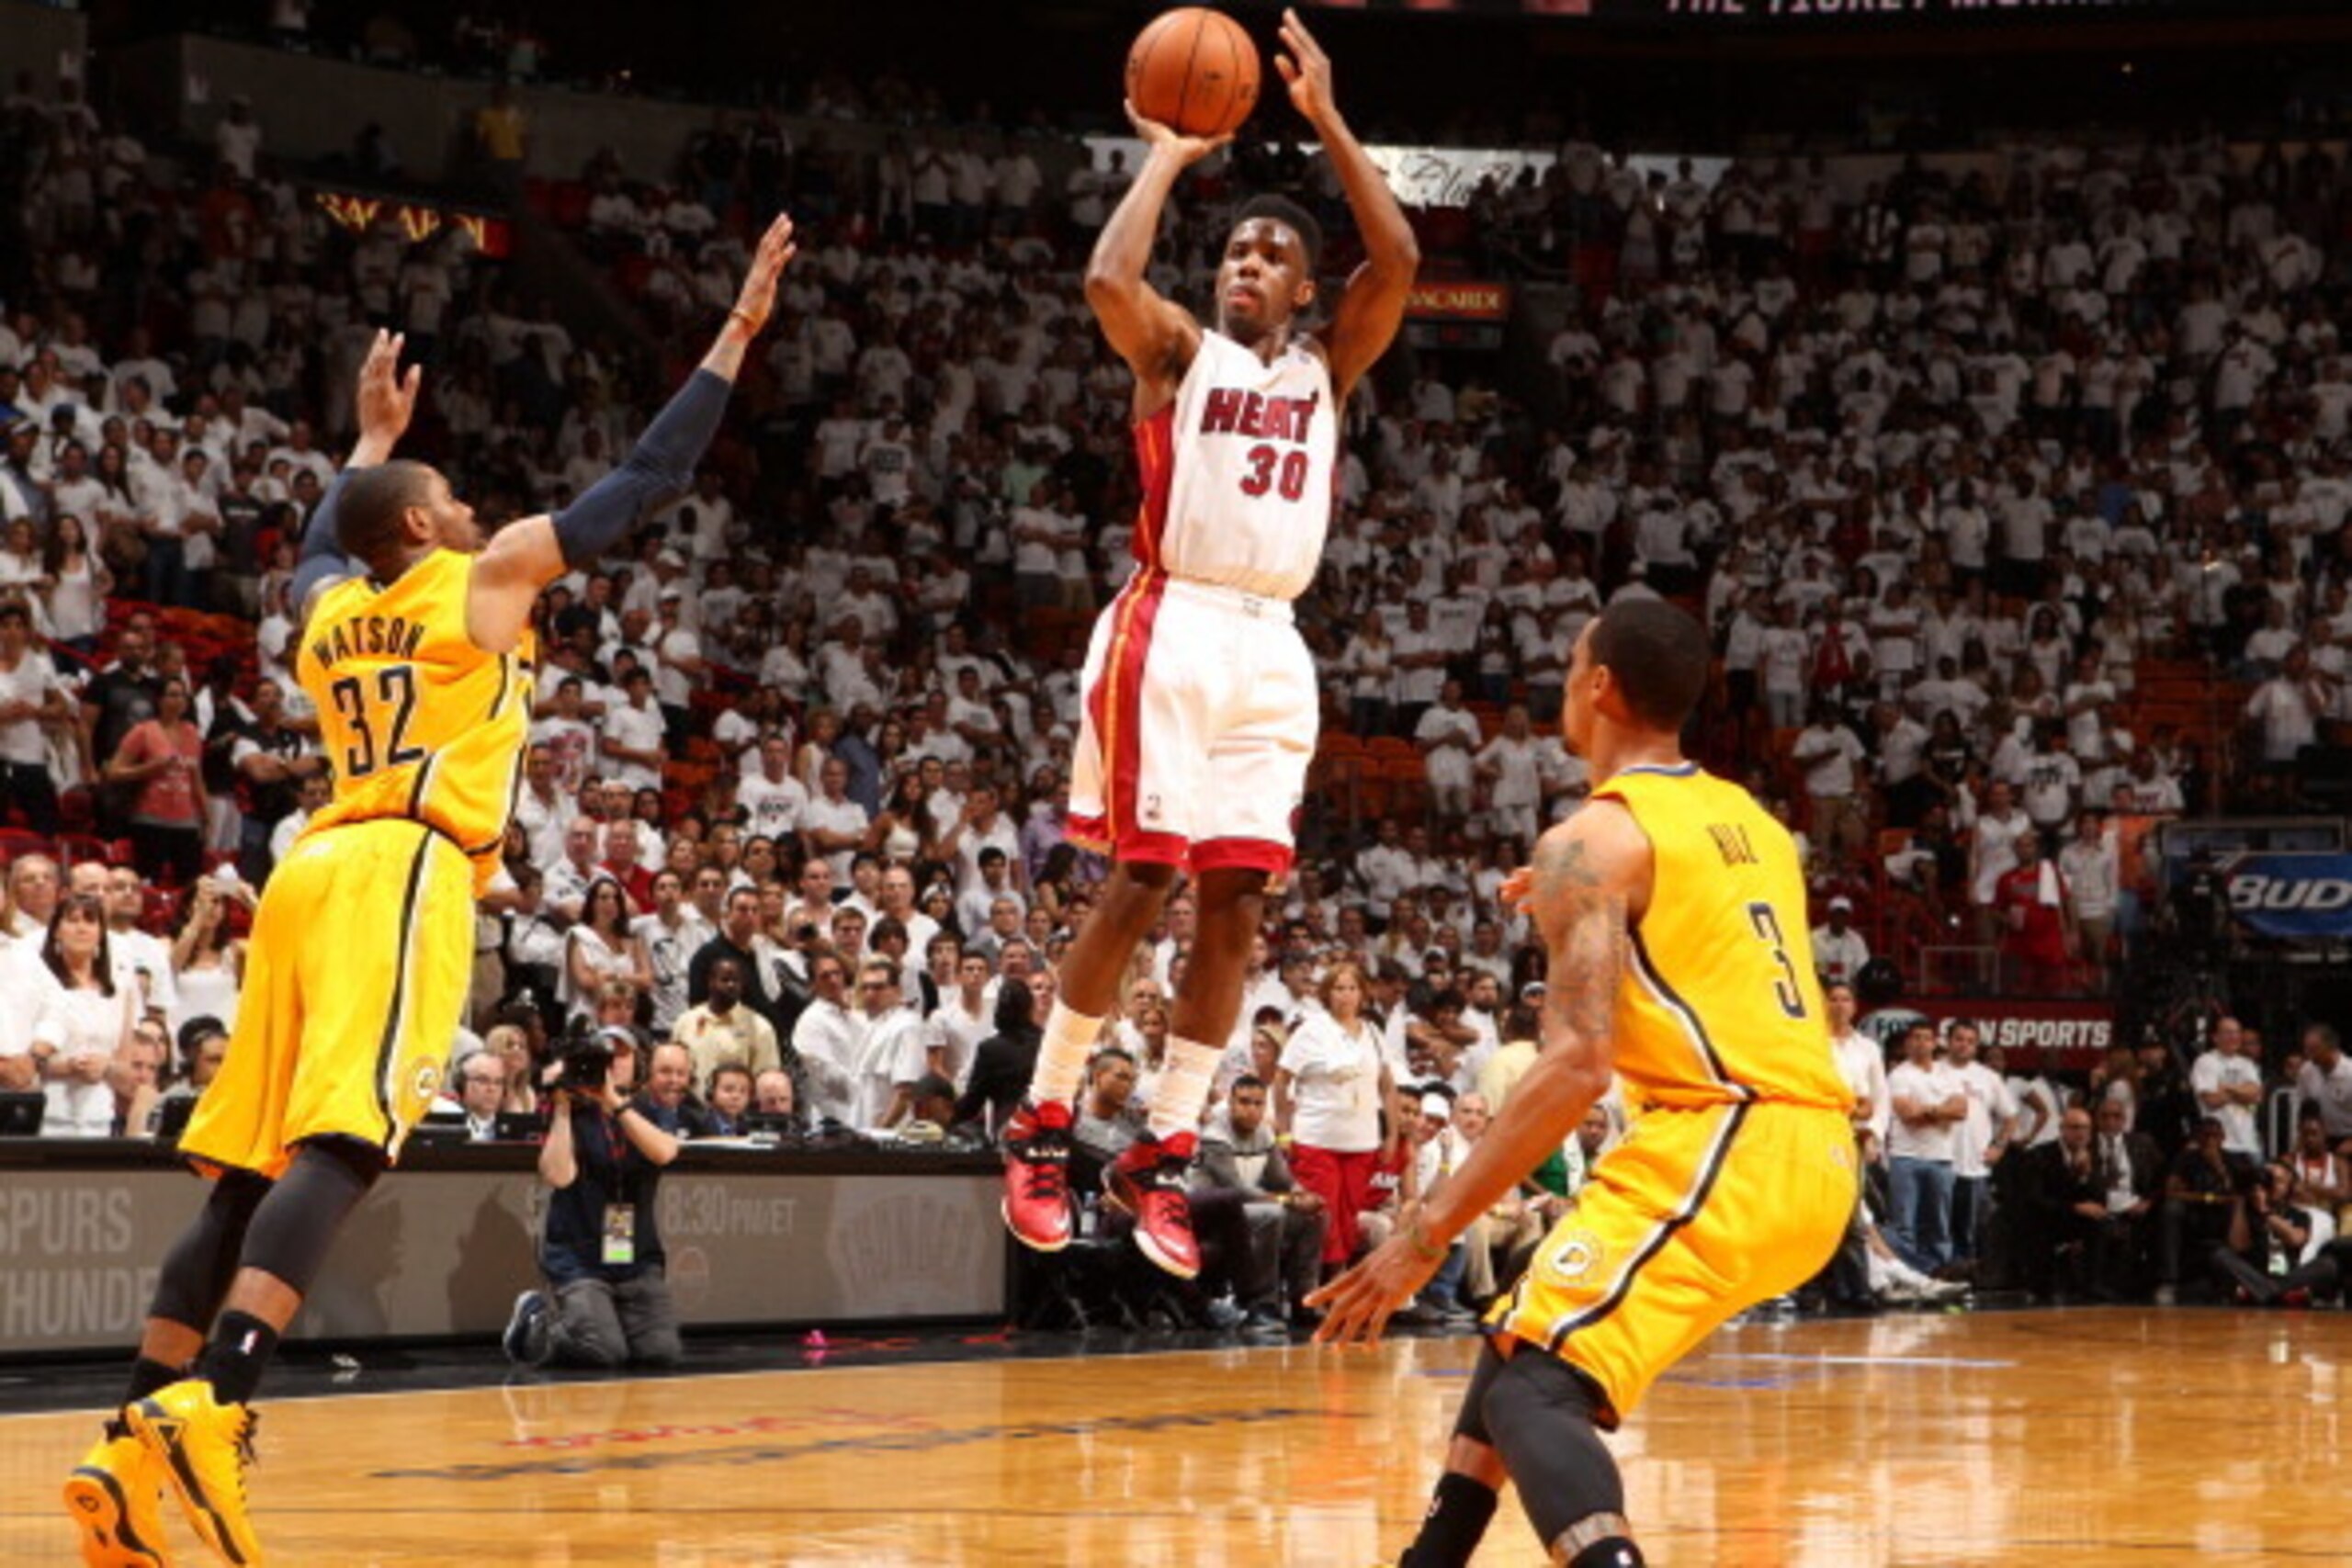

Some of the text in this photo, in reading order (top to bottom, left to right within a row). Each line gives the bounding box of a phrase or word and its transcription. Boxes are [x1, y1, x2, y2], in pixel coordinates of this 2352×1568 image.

[1200, 387, 1318, 444] HEAT
[1238, 444, 1308, 502] 30
[312, 615, 424, 671] WATSON
[333, 665, 424, 777] 32
[2228, 874, 2352, 908] BUD
[1747, 901, 1807, 1019] 3
[1939, 1017, 1996, 1046] SN
[1998, 1020, 2112, 1047] SPORTS
